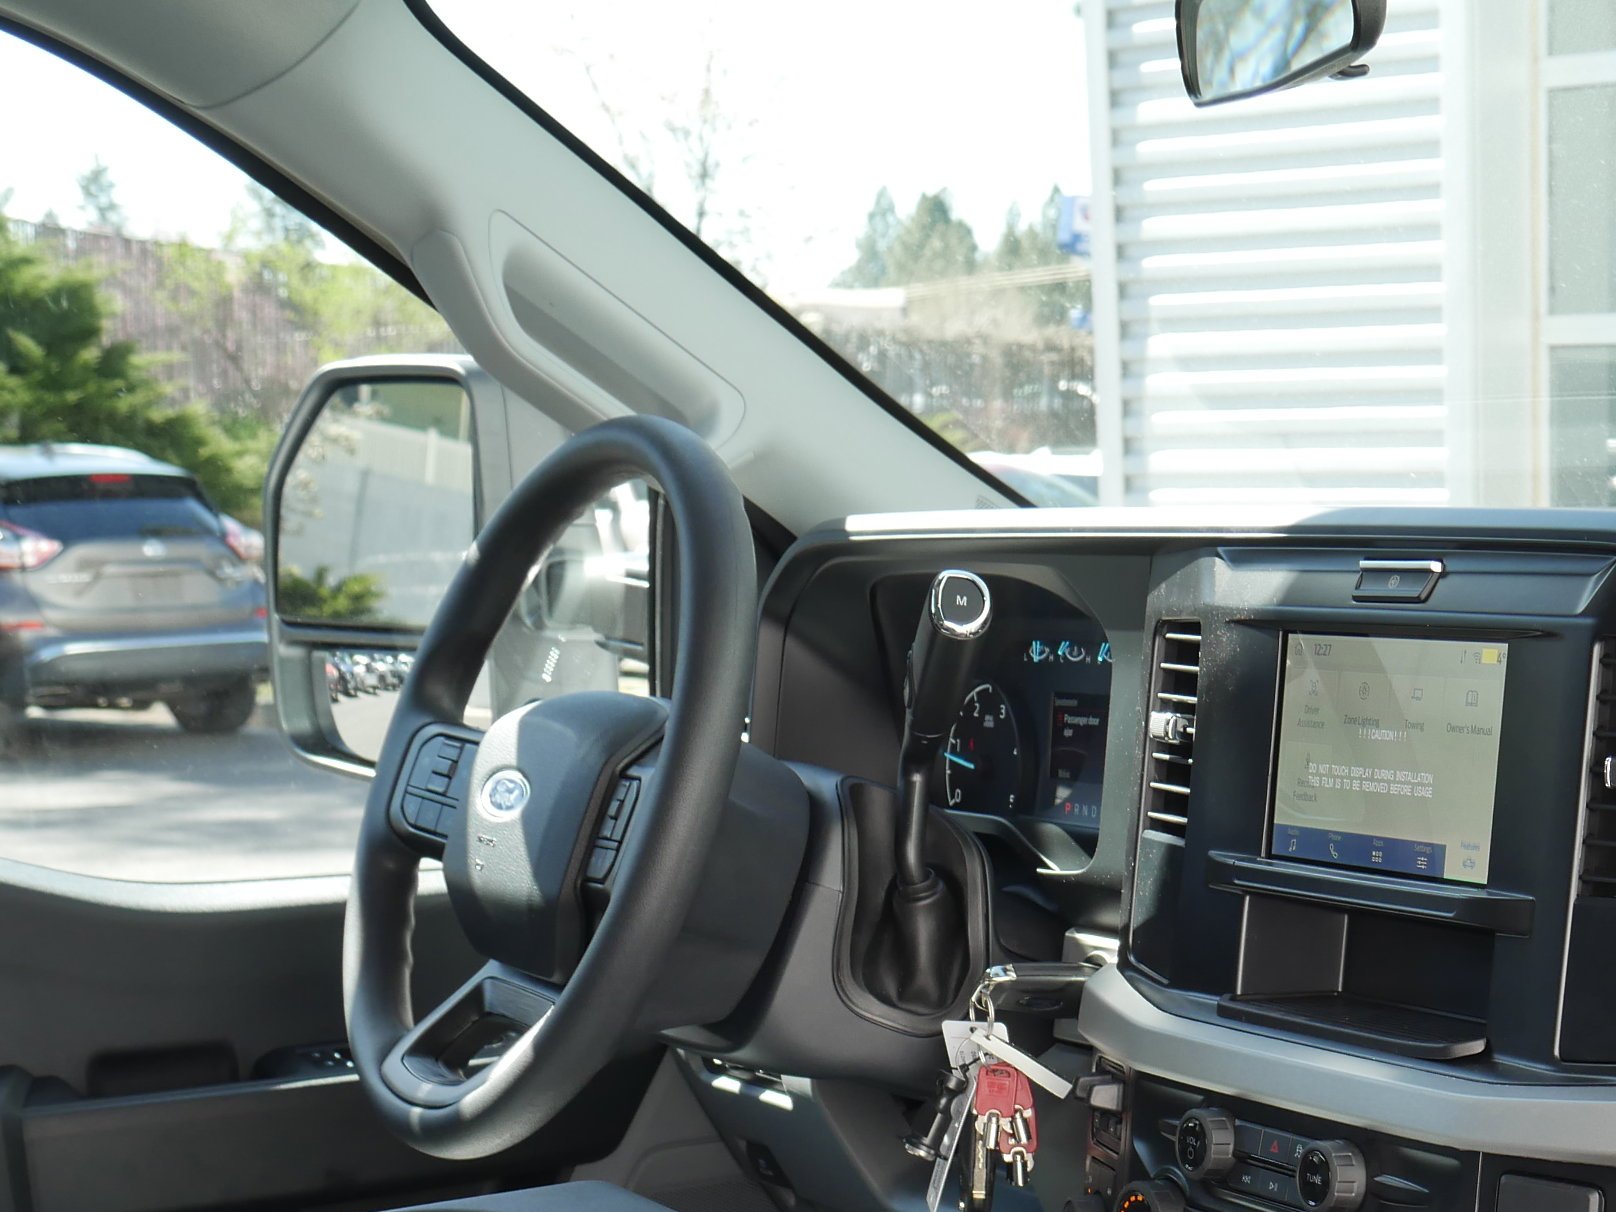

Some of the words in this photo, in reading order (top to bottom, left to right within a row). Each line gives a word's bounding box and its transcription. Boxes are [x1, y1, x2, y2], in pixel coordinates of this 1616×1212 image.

[956, 594, 968, 607] M
[1313, 643, 1332, 657] 12:27
[1343, 714, 1358, 726] Zone
[1358, 715, 1380, 729] Lighting
[1404, 719, 1425, 733] Towing
[1446, 722, 1470, 736] Owner's
[1470, 723, 1493, 737] Manual
[1308, 762, 1317, 774] DO
[1318, 763, 1330, 775] NOT
[1331, 764, 1349, 776] TOUCH
[1350, 766, 1372, 778] DISPLAY
[1374, 768, 1394, 780] DURING
[1395, 770, 1434, 785] INSTALLATION
[1308, 775, 1320, 787] THIS
[1322, 776, 1334, 788] FILM
[1343, 778, 1351, 790] TO
[1352, 779, 1360, 791] BE
[1362, 780, 1388, 793] REMOVED
[1389, 783, 1412, 796] BEFORE
[1413, 785, 1433, 798] USAGE
[1306, 1172, 1323, 1186] TUNE
